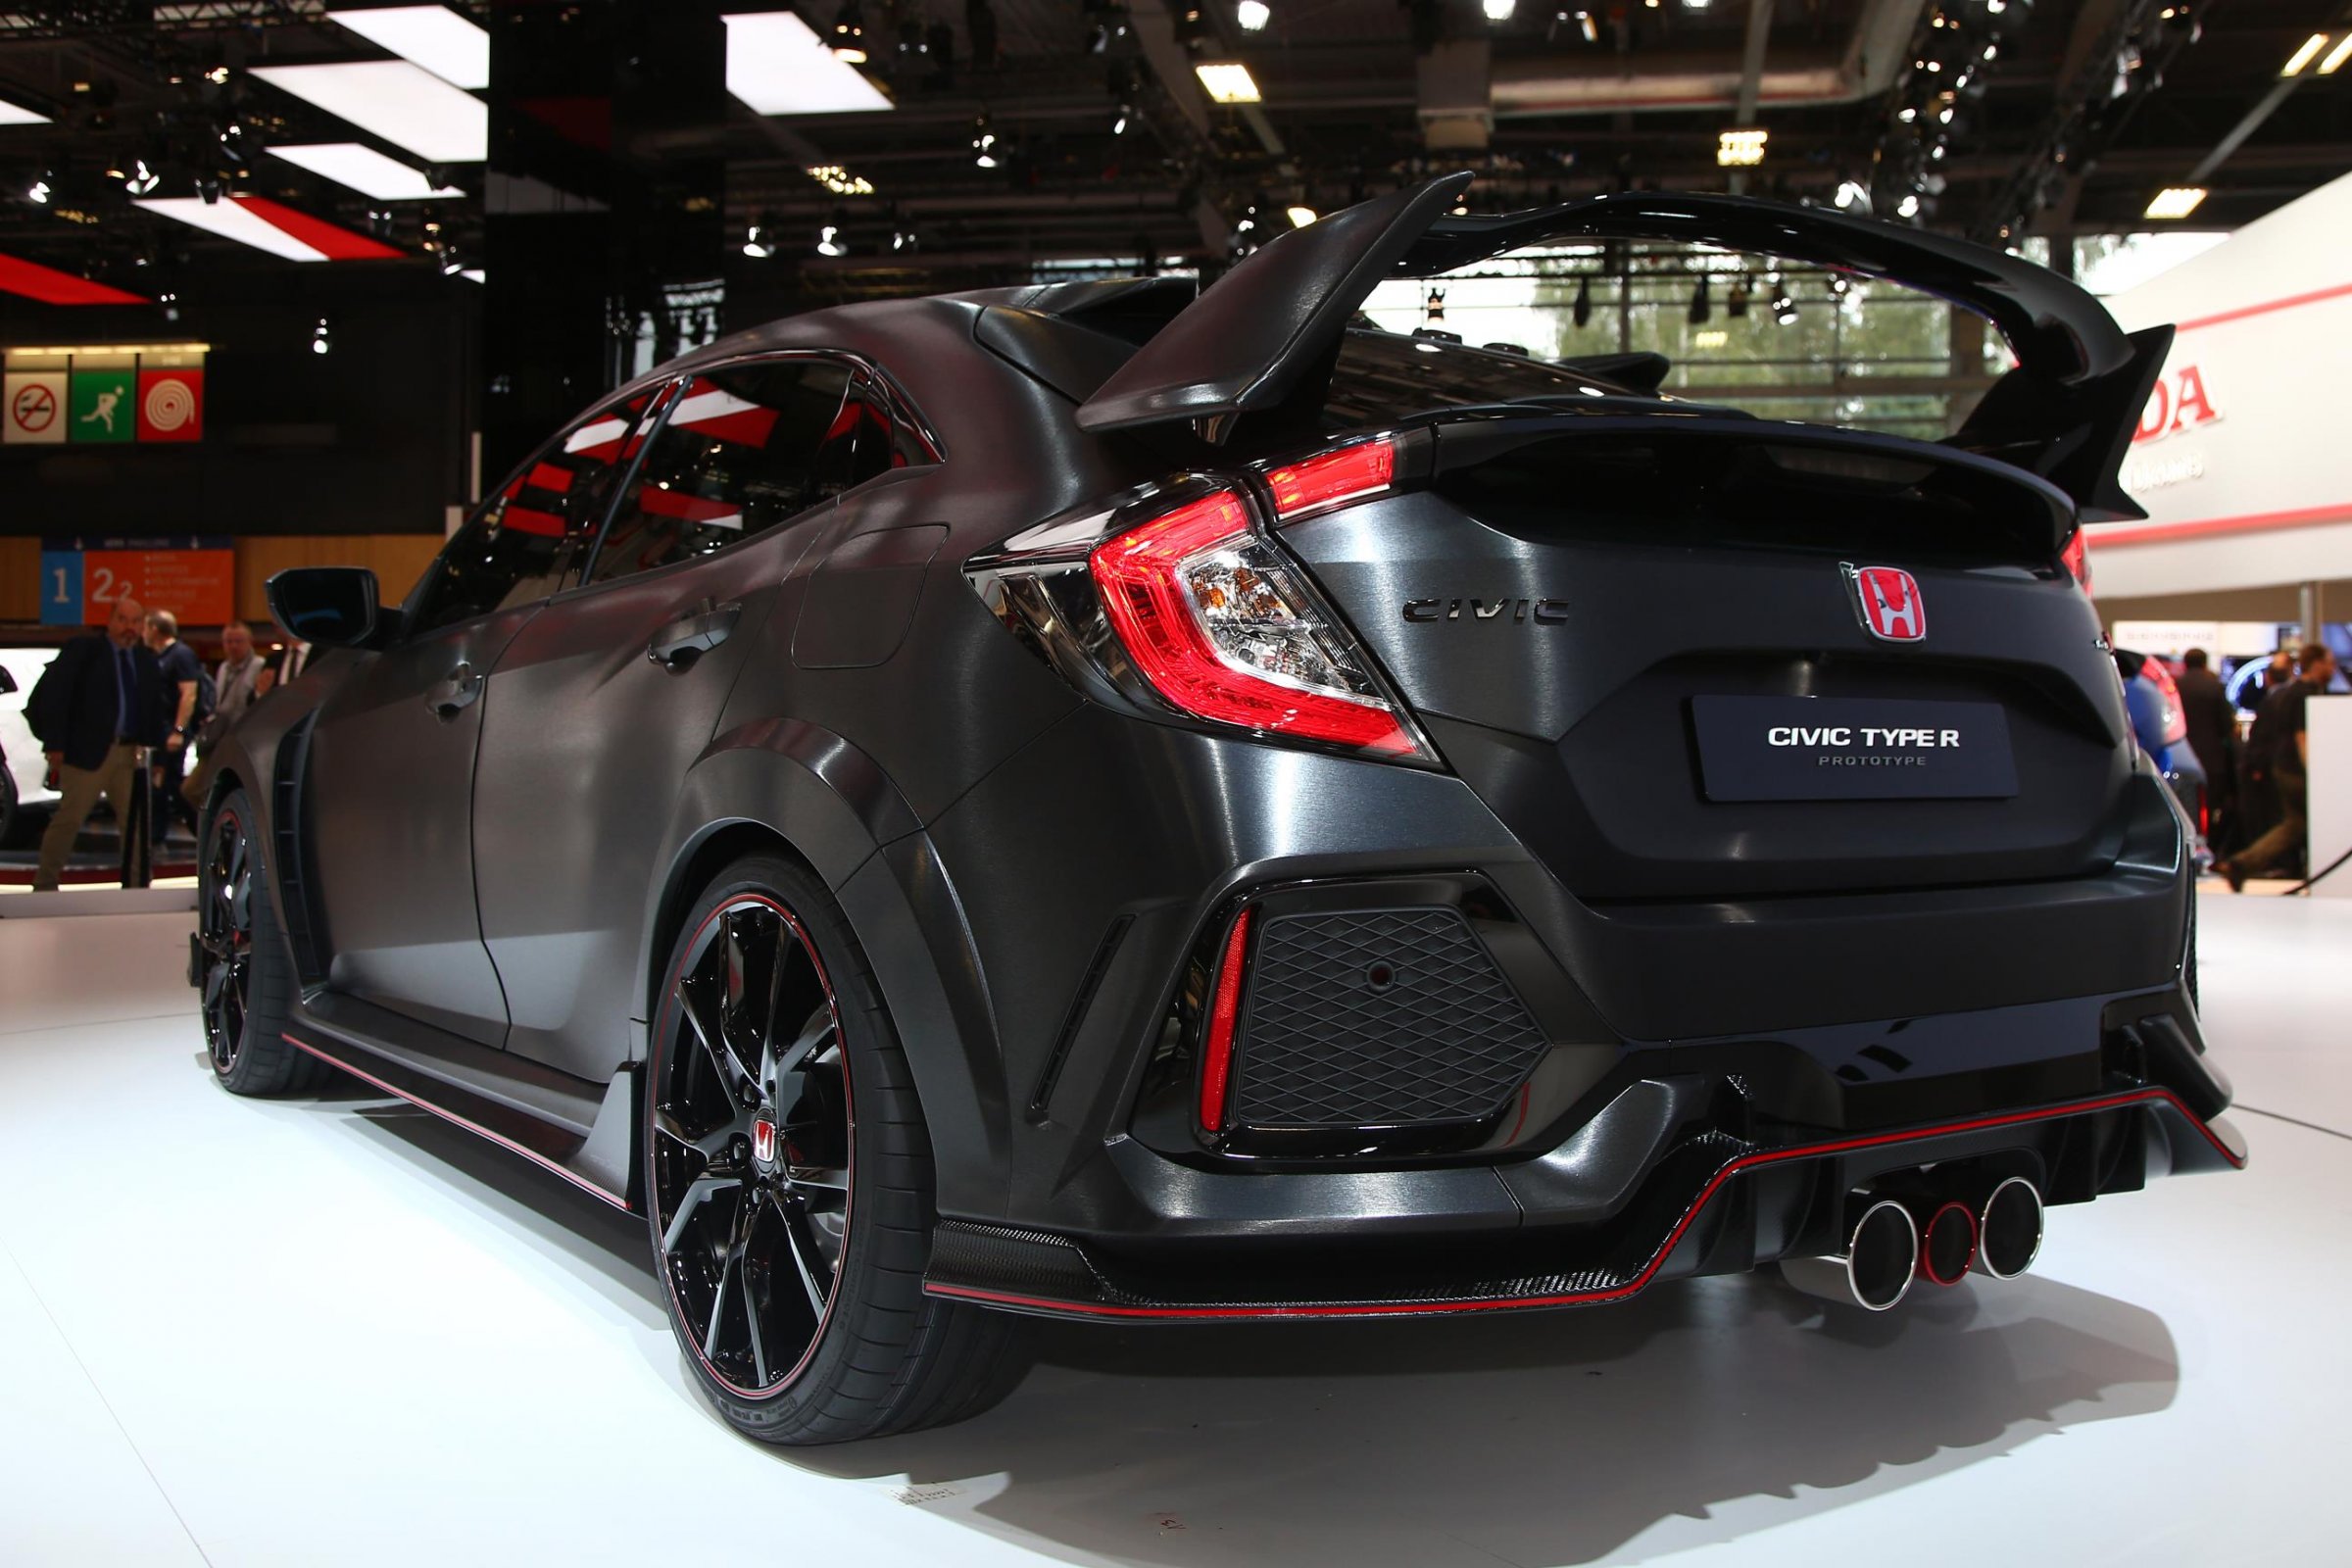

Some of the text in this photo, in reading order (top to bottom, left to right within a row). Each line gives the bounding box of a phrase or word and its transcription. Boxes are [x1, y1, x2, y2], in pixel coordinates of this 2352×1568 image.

[53, 567, 70, 603] 1
[1402, 598, 1569, 625] CIVIC
[1767, 726, 1960, 748] CIVIC TYPE R
[1819, 756, 1927, 766] PROTOTYPE
